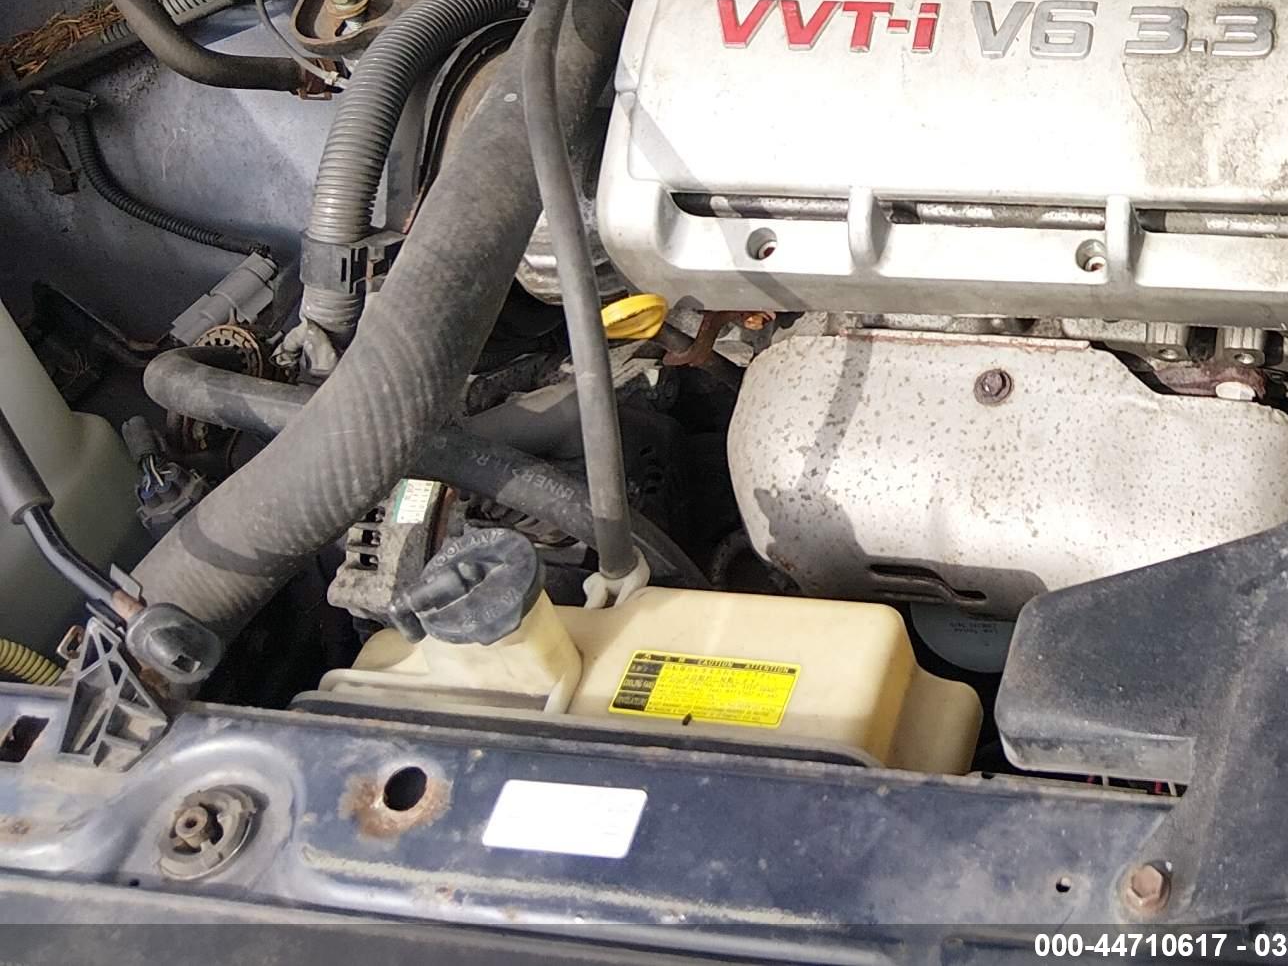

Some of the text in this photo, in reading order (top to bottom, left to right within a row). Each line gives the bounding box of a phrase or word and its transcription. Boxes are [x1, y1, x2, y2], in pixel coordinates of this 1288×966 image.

[970, 0, 1100, 60] V6
[1124, 5, 1276, 60] 3.3
[698, 659, 732, 668] CAUTION
